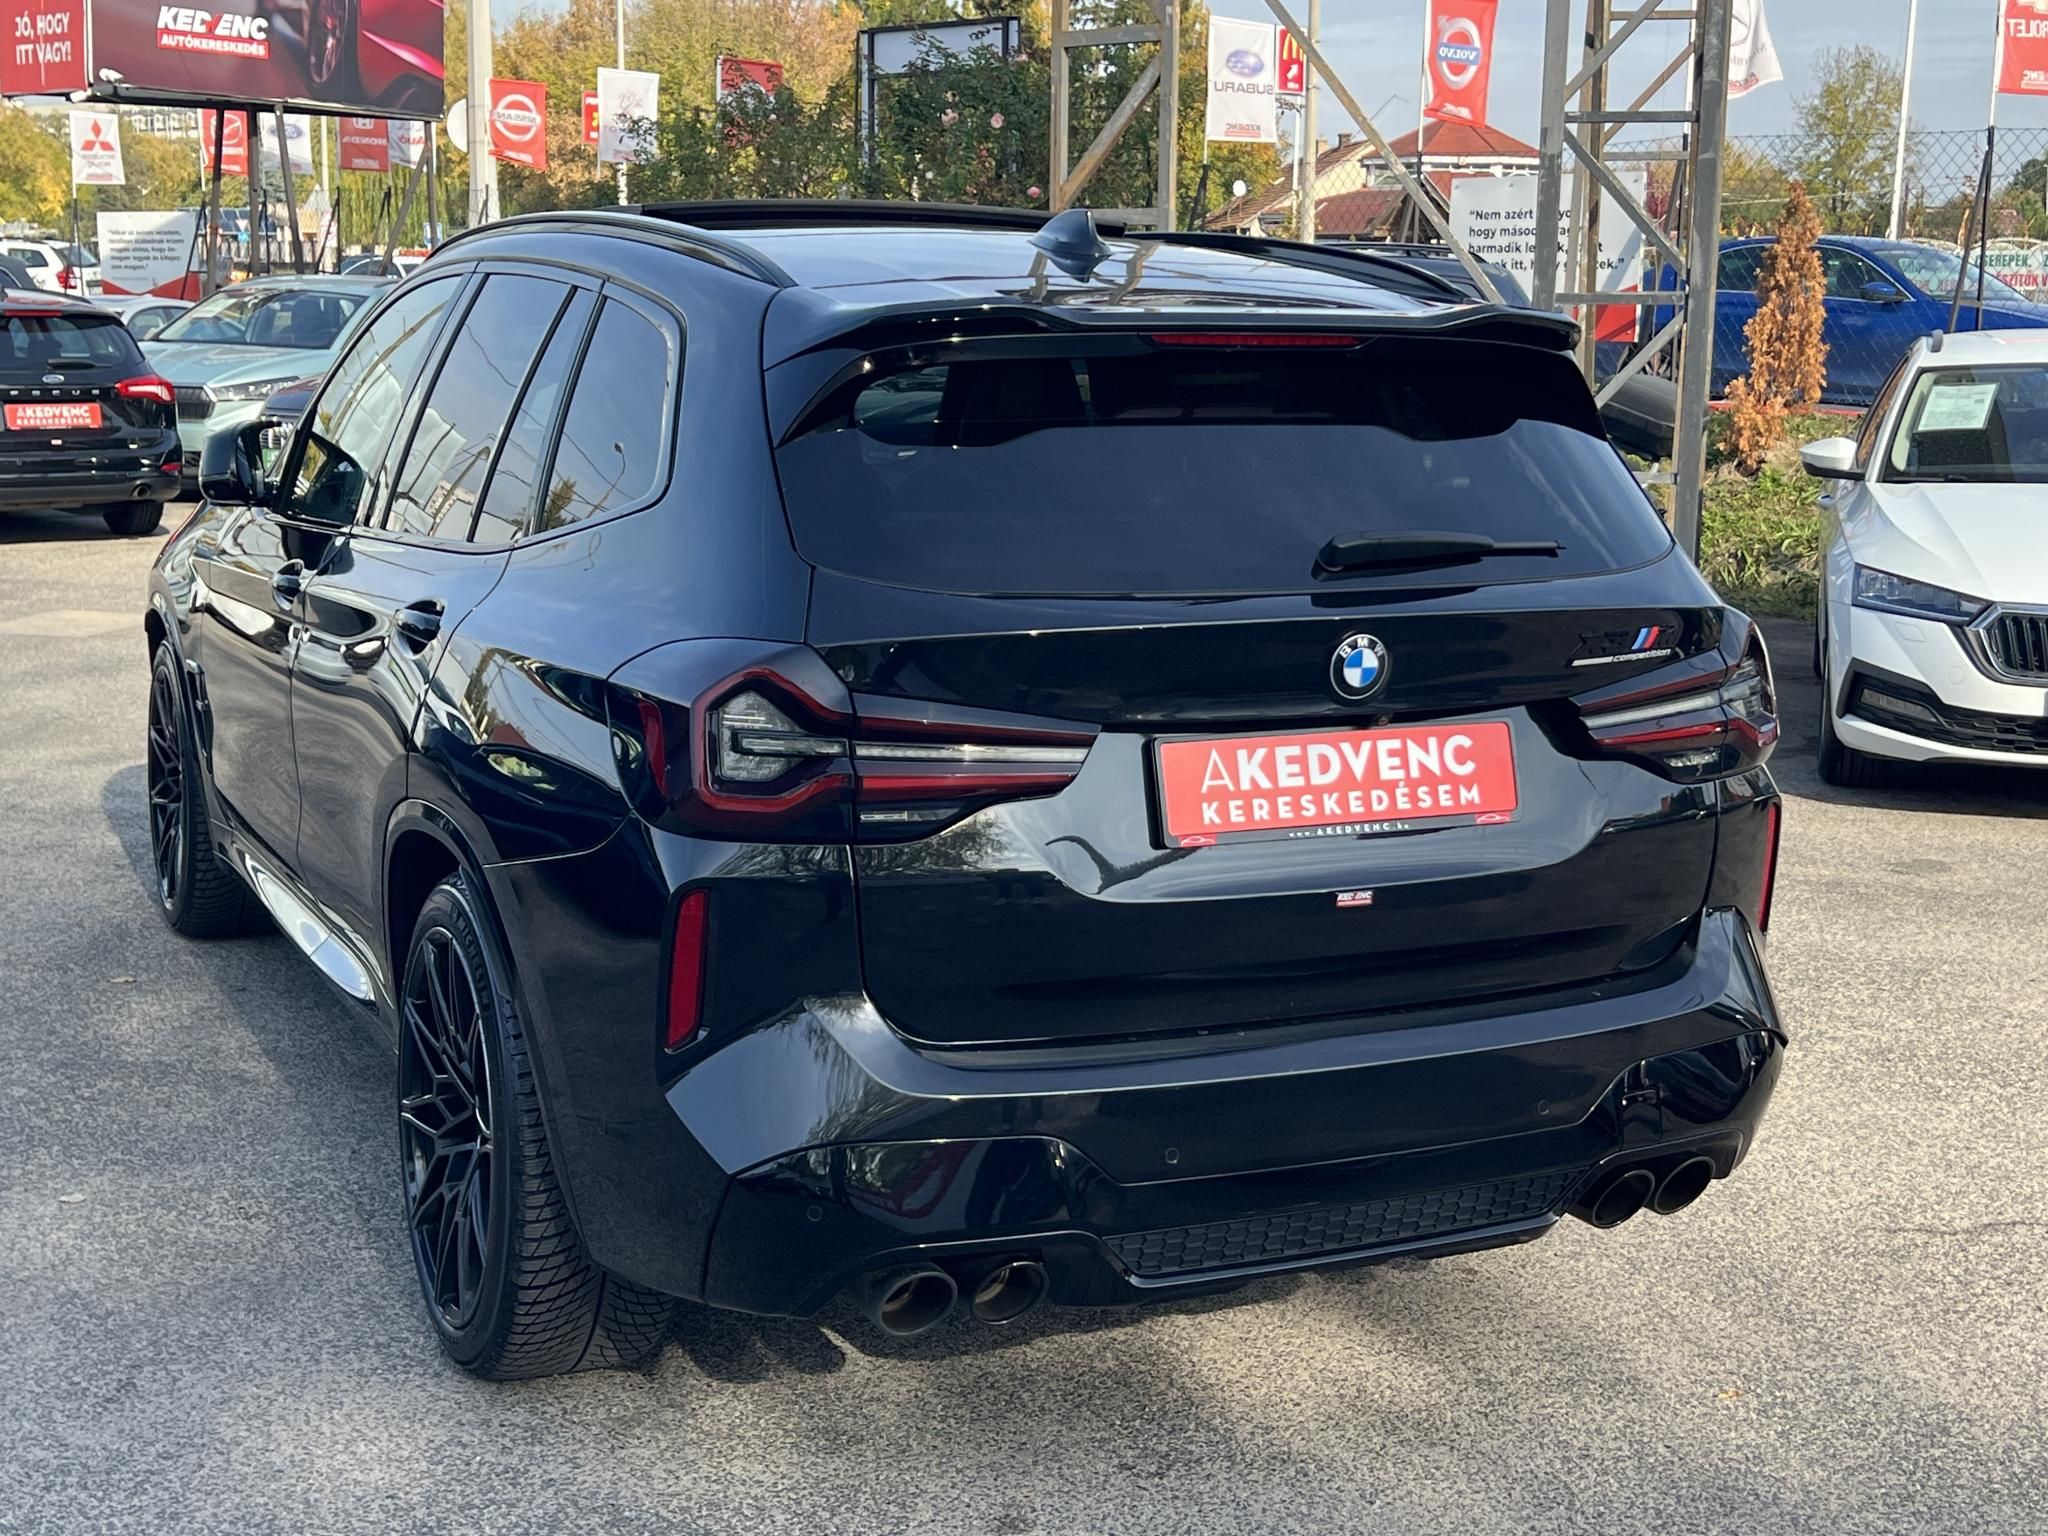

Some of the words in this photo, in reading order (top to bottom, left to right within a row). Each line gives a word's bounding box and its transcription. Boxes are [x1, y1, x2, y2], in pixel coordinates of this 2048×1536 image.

[15, 11, 34, 39] JÓ,
[36, 12, 70, 35] HOGY
[157, 5, 269, 40] KEDVENC
[15, 43, 33, 65] ITT
[36, 41, 72, 64] VAGY!
[160, 33, 267, 56] AUTÓKERESKEDÉS
[1504, 208, 1533, 220] azért
[1469, 226, 1496, 239] hogy
[1469, 242, 1522, 254] harmadik
[1511, 258, 1527, 272] itt,
[1339, 637, 1384, 659] BMW
[1613, 648, 1672, 662] competition
[1201, 782, 1481, 826] KERESKEDÉSEM
